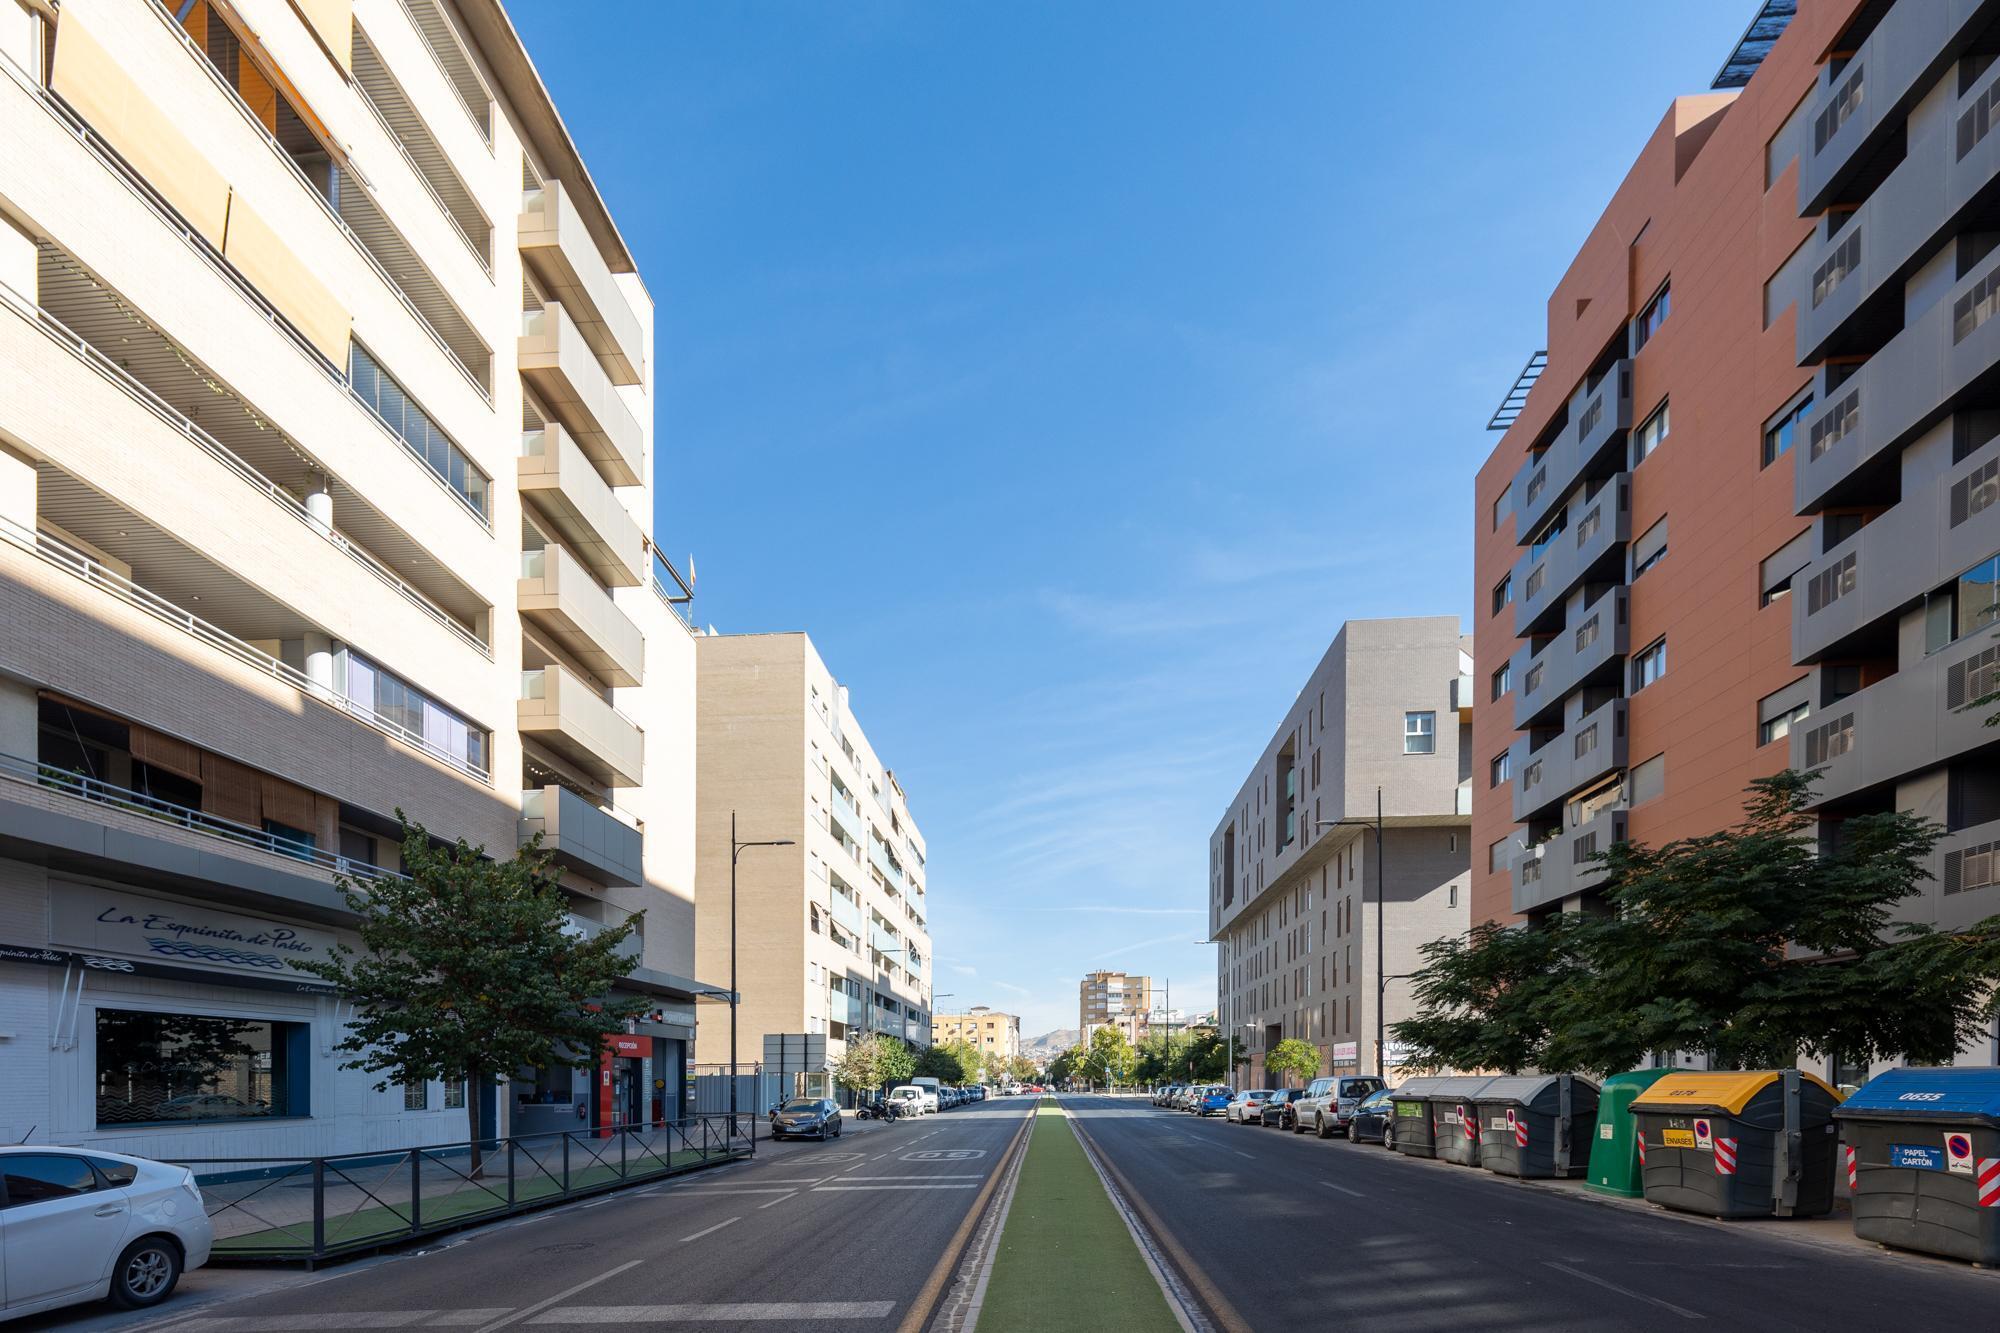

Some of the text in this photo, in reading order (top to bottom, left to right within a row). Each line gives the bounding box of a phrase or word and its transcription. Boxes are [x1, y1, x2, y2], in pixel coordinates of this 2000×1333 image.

[96, 907, 313, 953] La Esquinita de Pablo
[1898, 1092, 1946, 1101] 0655
[1666, 1137, 1693, 1146] ENVASES
[1904, 1149, 1928, 1157] PAPEL
[1901, 1157, 1933, 1167] CARTÓN
